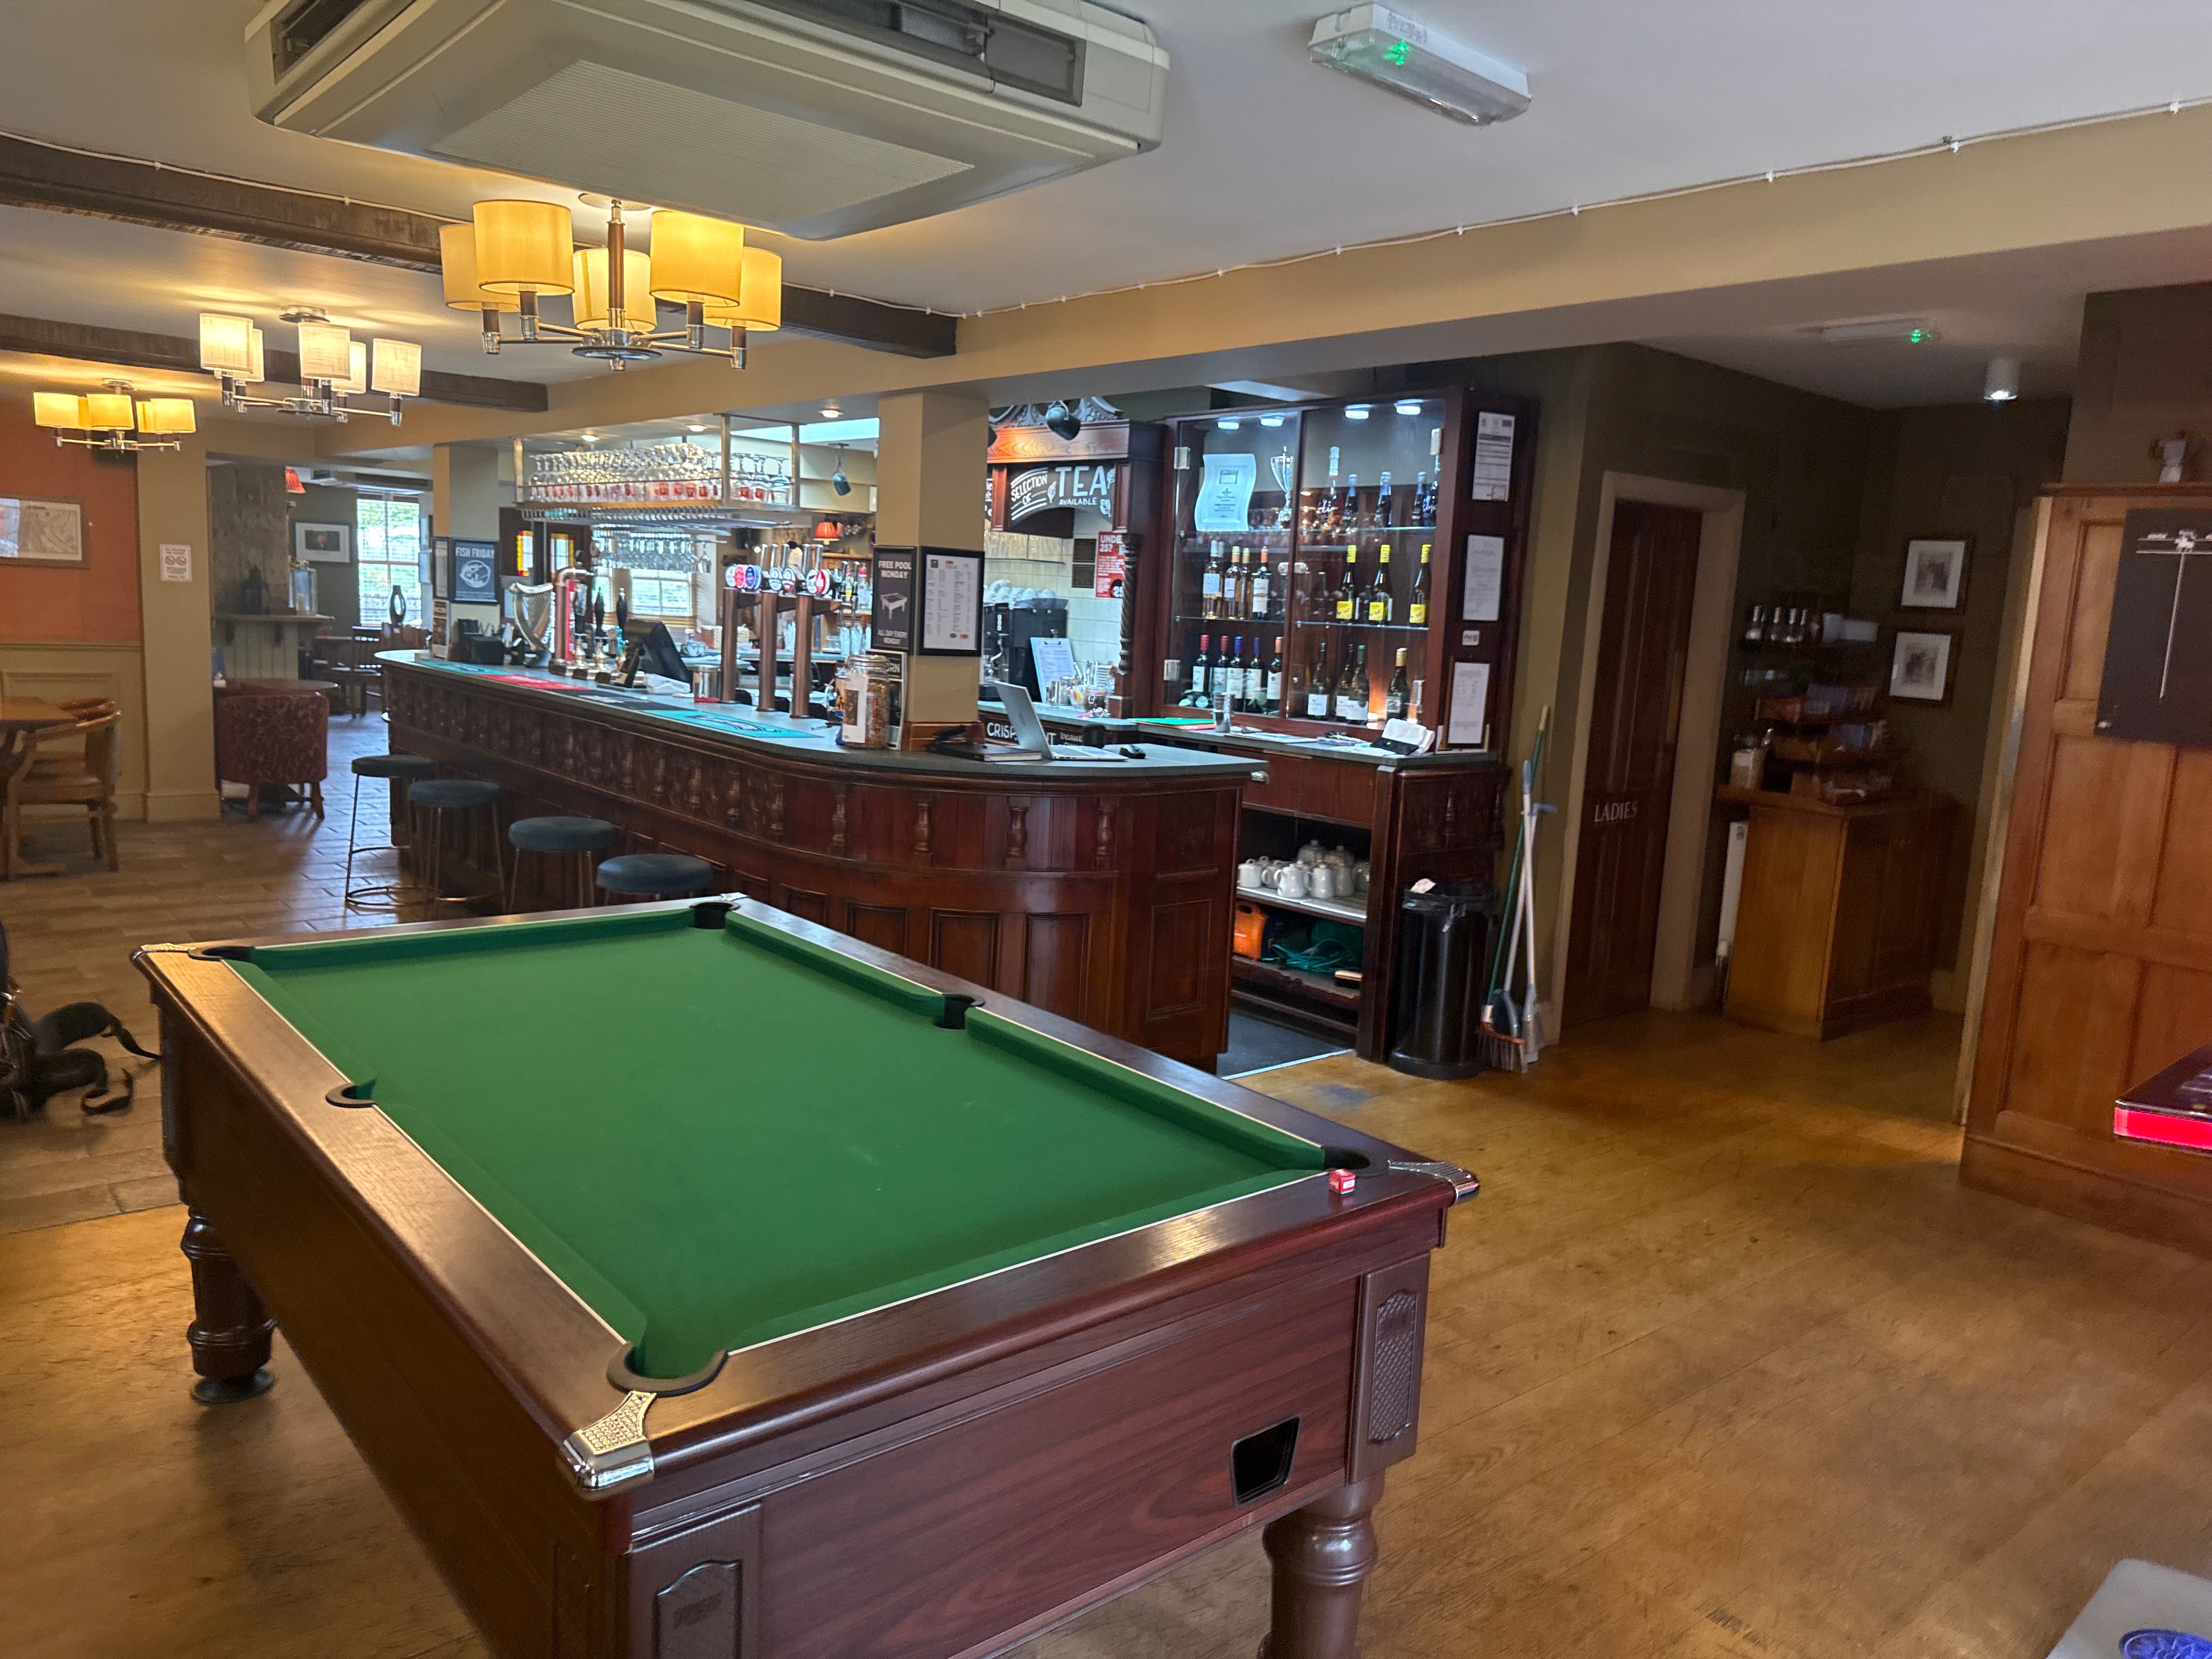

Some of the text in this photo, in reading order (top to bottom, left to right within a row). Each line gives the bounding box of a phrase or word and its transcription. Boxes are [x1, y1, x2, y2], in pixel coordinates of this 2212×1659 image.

[1055, 466, 1107, 497] TEA
[1011, 475, 1048, 502] SELECTION
[1023, 493, 1032, 506] OF
[1059, 497, 1097, 505] AVAILABLE
[456, 547, 495, 558] FISH FRIDAY
[1099, 544, 1113, 552] 25?
[878, 561, 894, 569] FREE
[881, 570, 908, 579] MONDAY
[1594, 801, 1637, 822] LADIES
